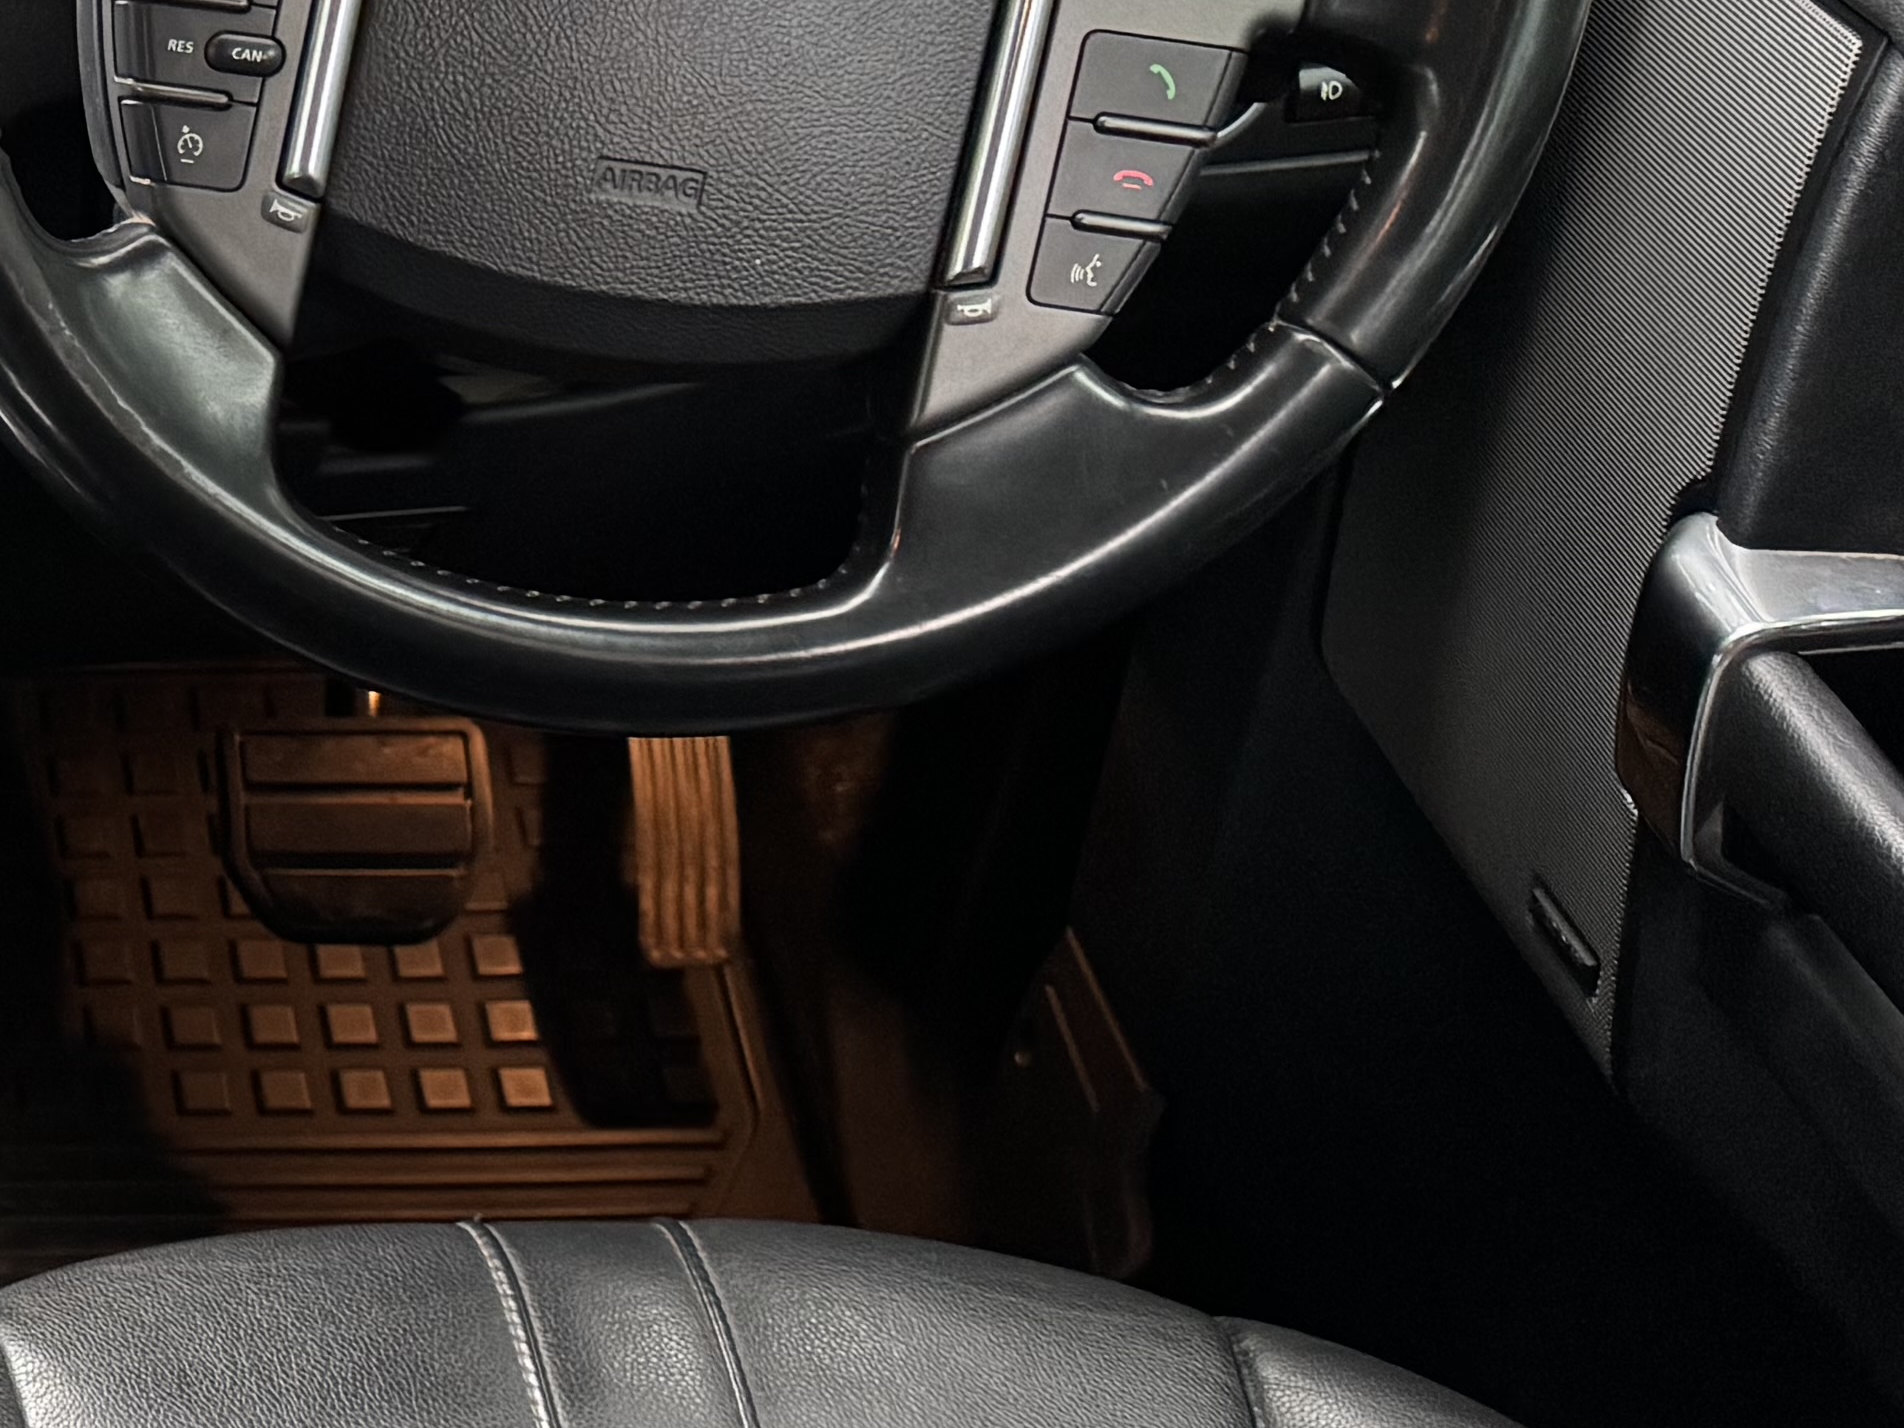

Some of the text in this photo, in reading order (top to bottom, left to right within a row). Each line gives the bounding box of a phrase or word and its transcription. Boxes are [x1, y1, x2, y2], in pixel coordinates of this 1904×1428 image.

[167, 38, 194, 54] RES
[231, 47, 263, 62] CAN
[596, 165, 700, 201] AIRBAG
